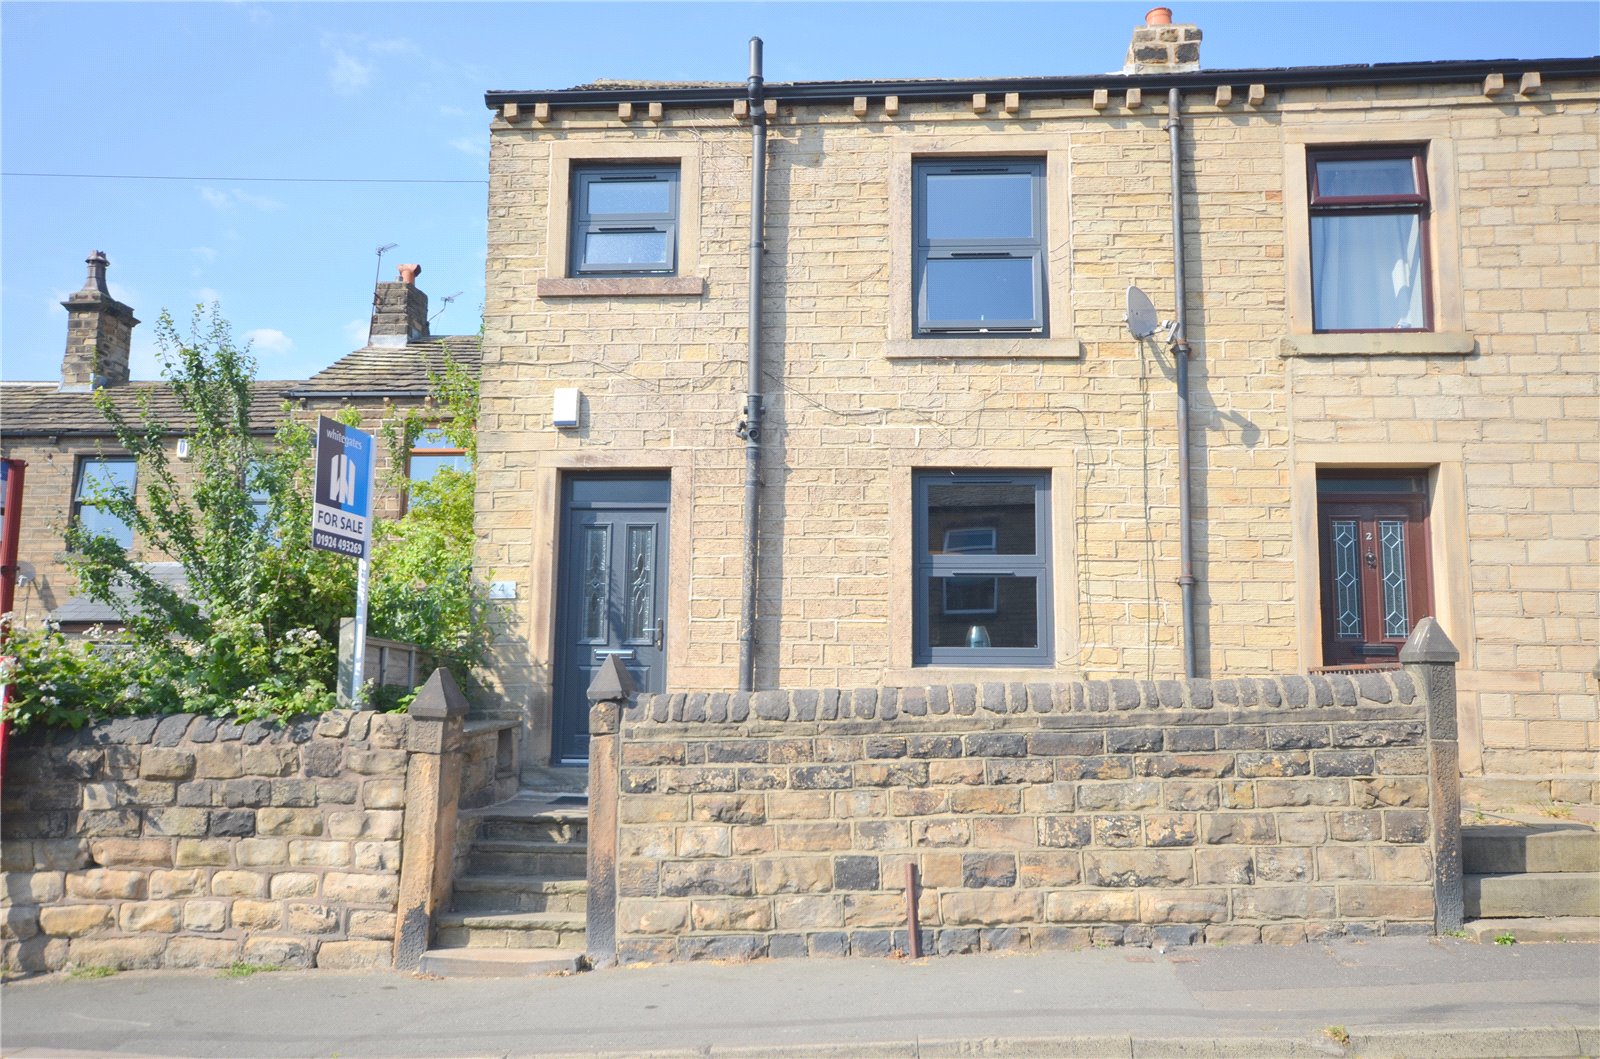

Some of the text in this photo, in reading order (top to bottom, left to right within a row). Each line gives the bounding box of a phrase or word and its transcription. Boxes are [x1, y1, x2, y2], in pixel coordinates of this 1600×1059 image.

[326, 428, 362, 450] whitegates
[317, 510, 363, 535] FOR SALE
[316, 533, 363, 555] 01924 493269
[1365, 532, 1373, 541] 2
